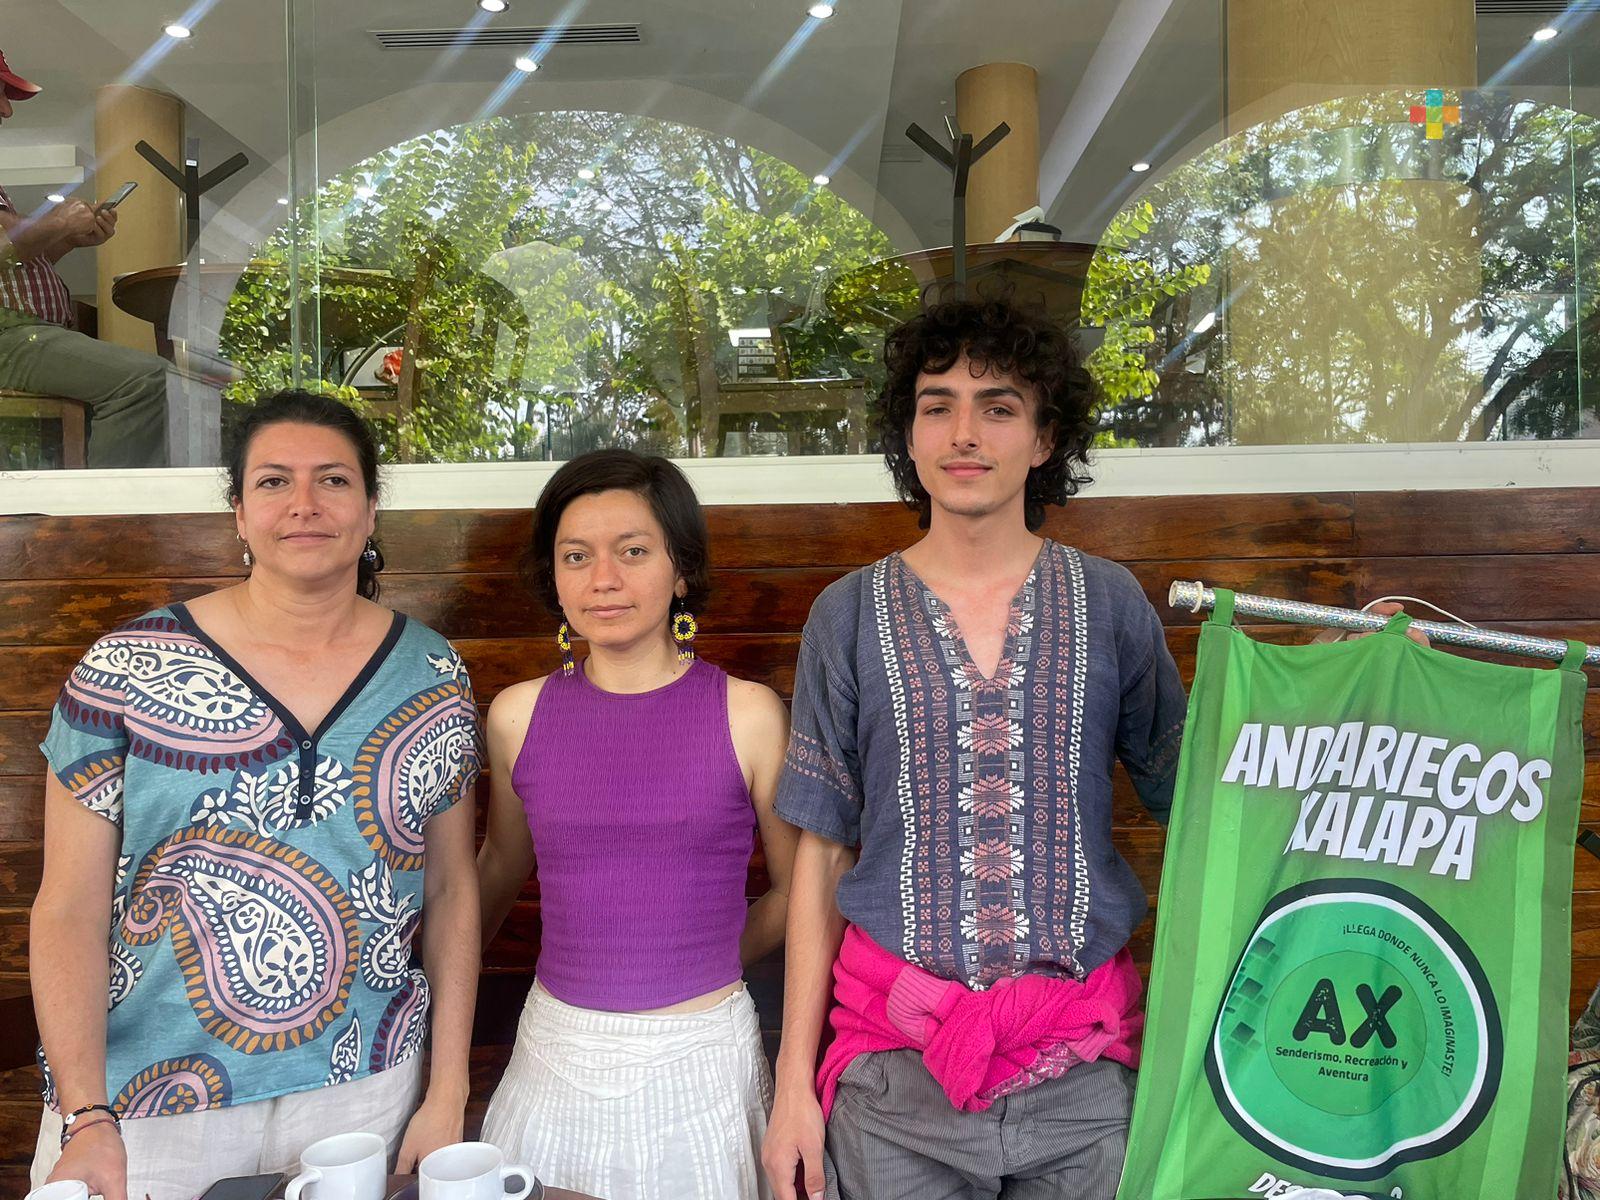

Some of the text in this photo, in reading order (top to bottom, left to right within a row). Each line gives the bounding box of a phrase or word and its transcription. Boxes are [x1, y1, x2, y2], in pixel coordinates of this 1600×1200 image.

[1221, 722, 1552, 822] ANDARIEGOS
[1283, 791, 1478, 880] XALAPA
[1292, 978, 1403, 1049] AX
[1378, 929, 1412, 955] DONDE
[1409, 952, 1439, 989] NUNCA
[1433, 989, 1447, 1005] LO
[1440, 1006, 1456, 1078] IMAGINASTE!
[1318, 1066, 1369, 1082] Aventura
[1344, 1054, 1399, 1067] Recreación
[1401, 1059, 1408, 1070] y
